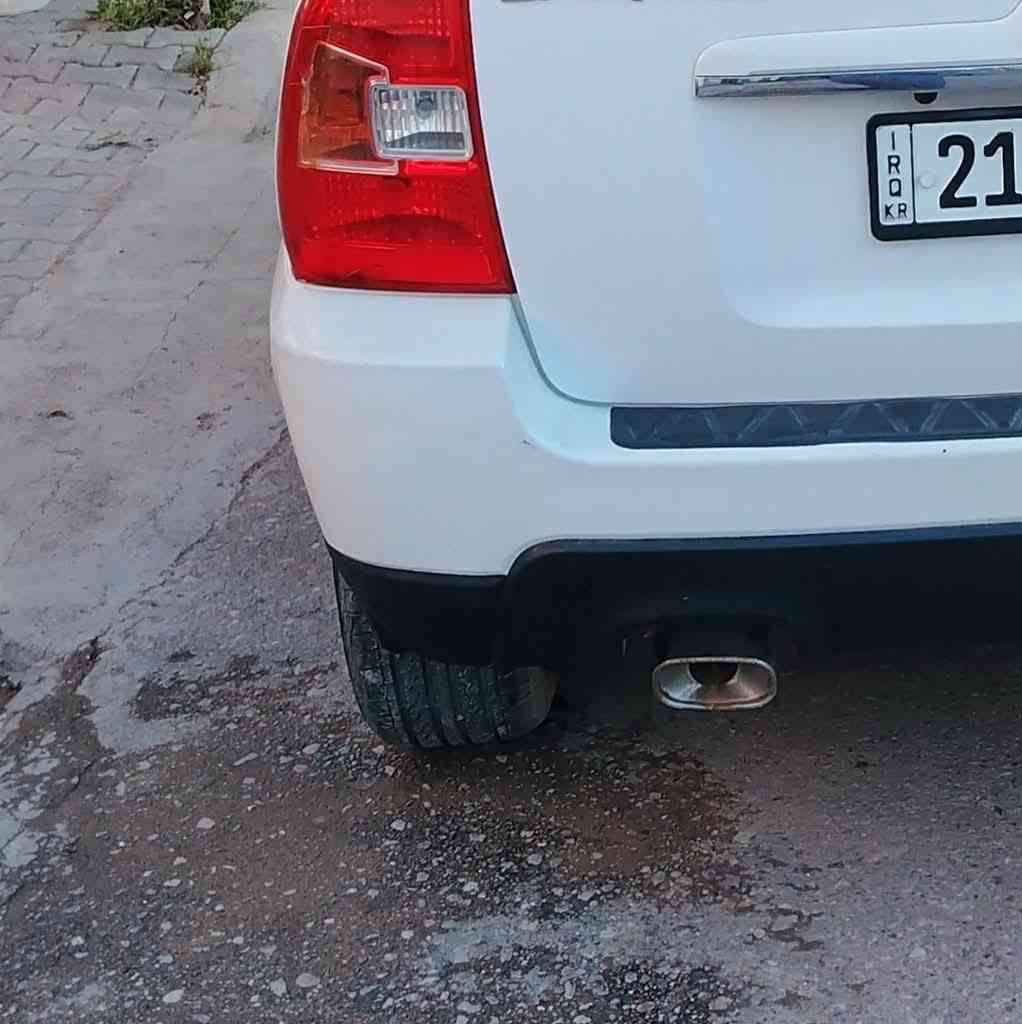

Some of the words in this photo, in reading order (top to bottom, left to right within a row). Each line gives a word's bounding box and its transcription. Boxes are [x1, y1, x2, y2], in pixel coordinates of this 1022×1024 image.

[887, 131, 902, 197] IRQ
[937, 132, 1022, 209] 21
[884, 202, 908, 219] KR
